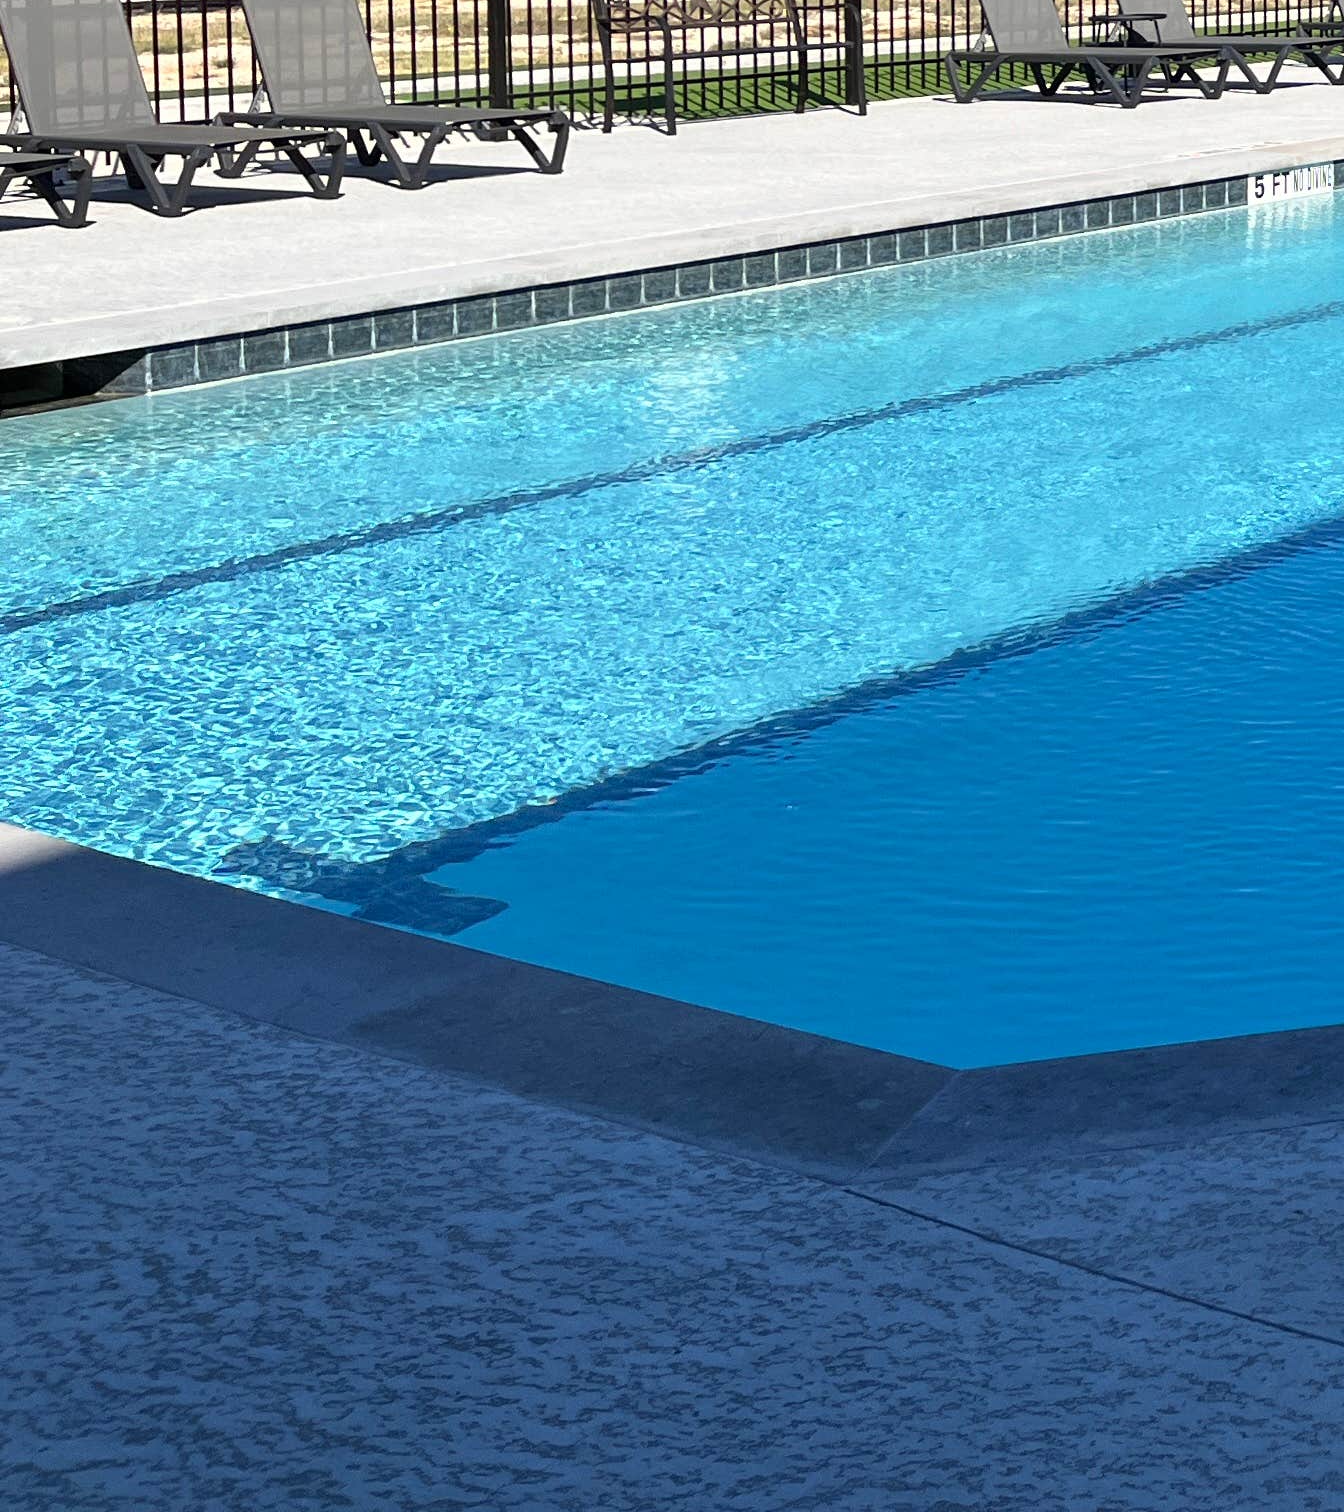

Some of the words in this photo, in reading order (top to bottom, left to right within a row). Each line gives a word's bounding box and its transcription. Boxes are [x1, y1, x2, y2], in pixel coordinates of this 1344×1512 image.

[1254, 175, 1265, 198] 5
[1272, 171, 1290, 196] FT
[1293, 168, 1303, 192] NO
